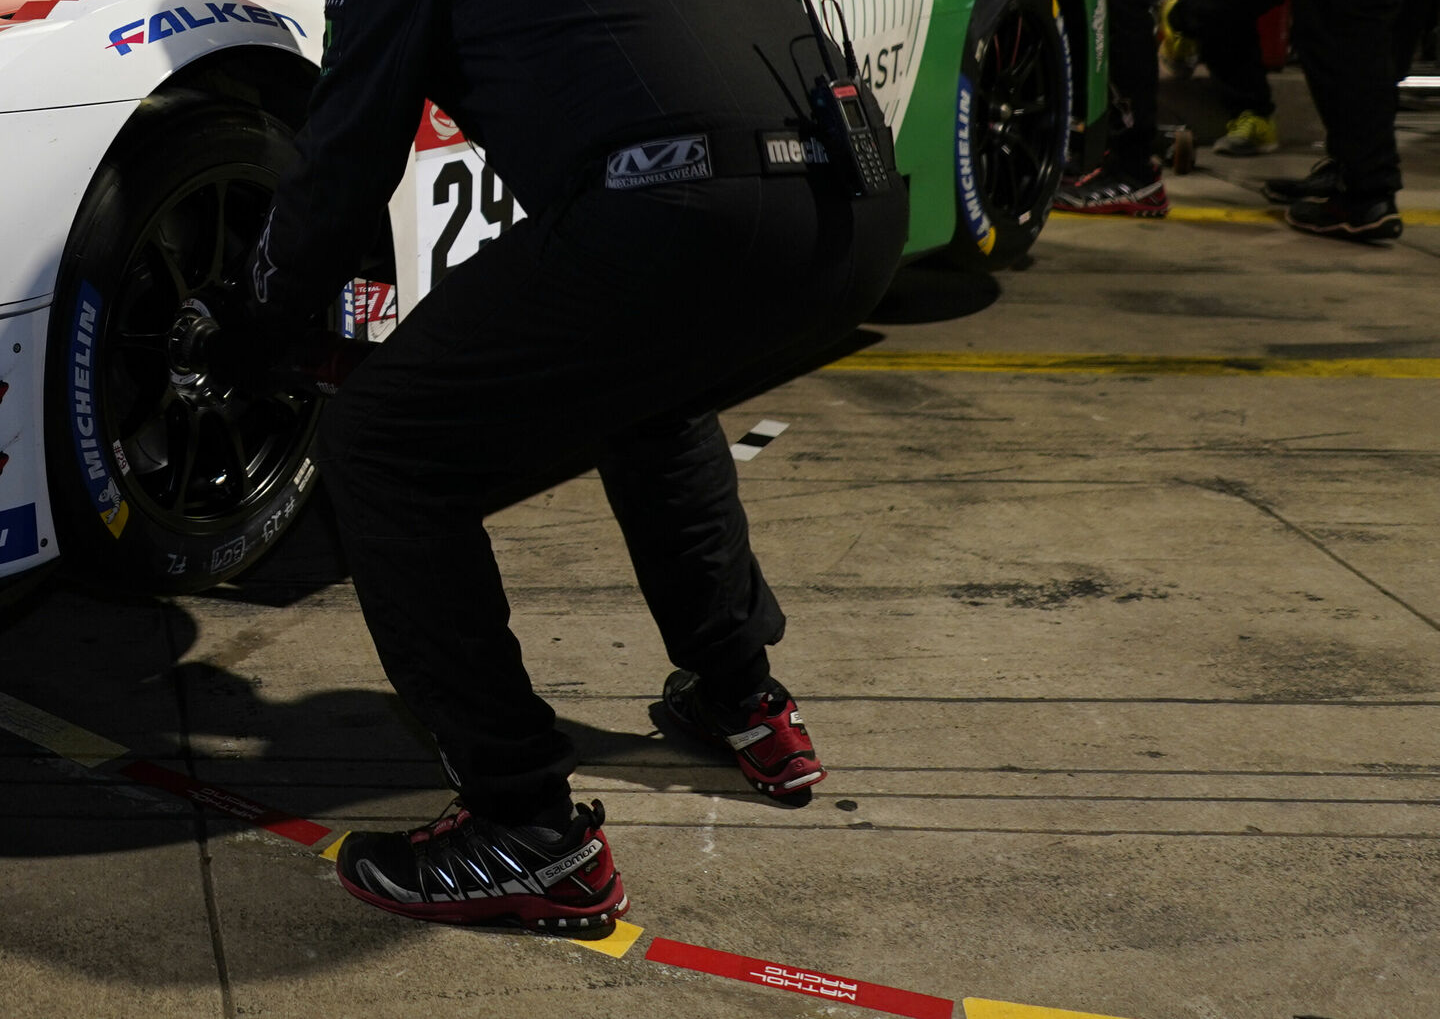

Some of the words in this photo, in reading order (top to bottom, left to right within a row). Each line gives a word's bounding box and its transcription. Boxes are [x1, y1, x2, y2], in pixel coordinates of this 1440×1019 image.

[105, 3, 308, 57] FALKEN
[958, 88, 989, 222] MICHELIN
[73, 300, 107, 481] MICHELIN
[749, 971, 856, 1001] MATHOL
[764, 966, 858, 992] RACING
